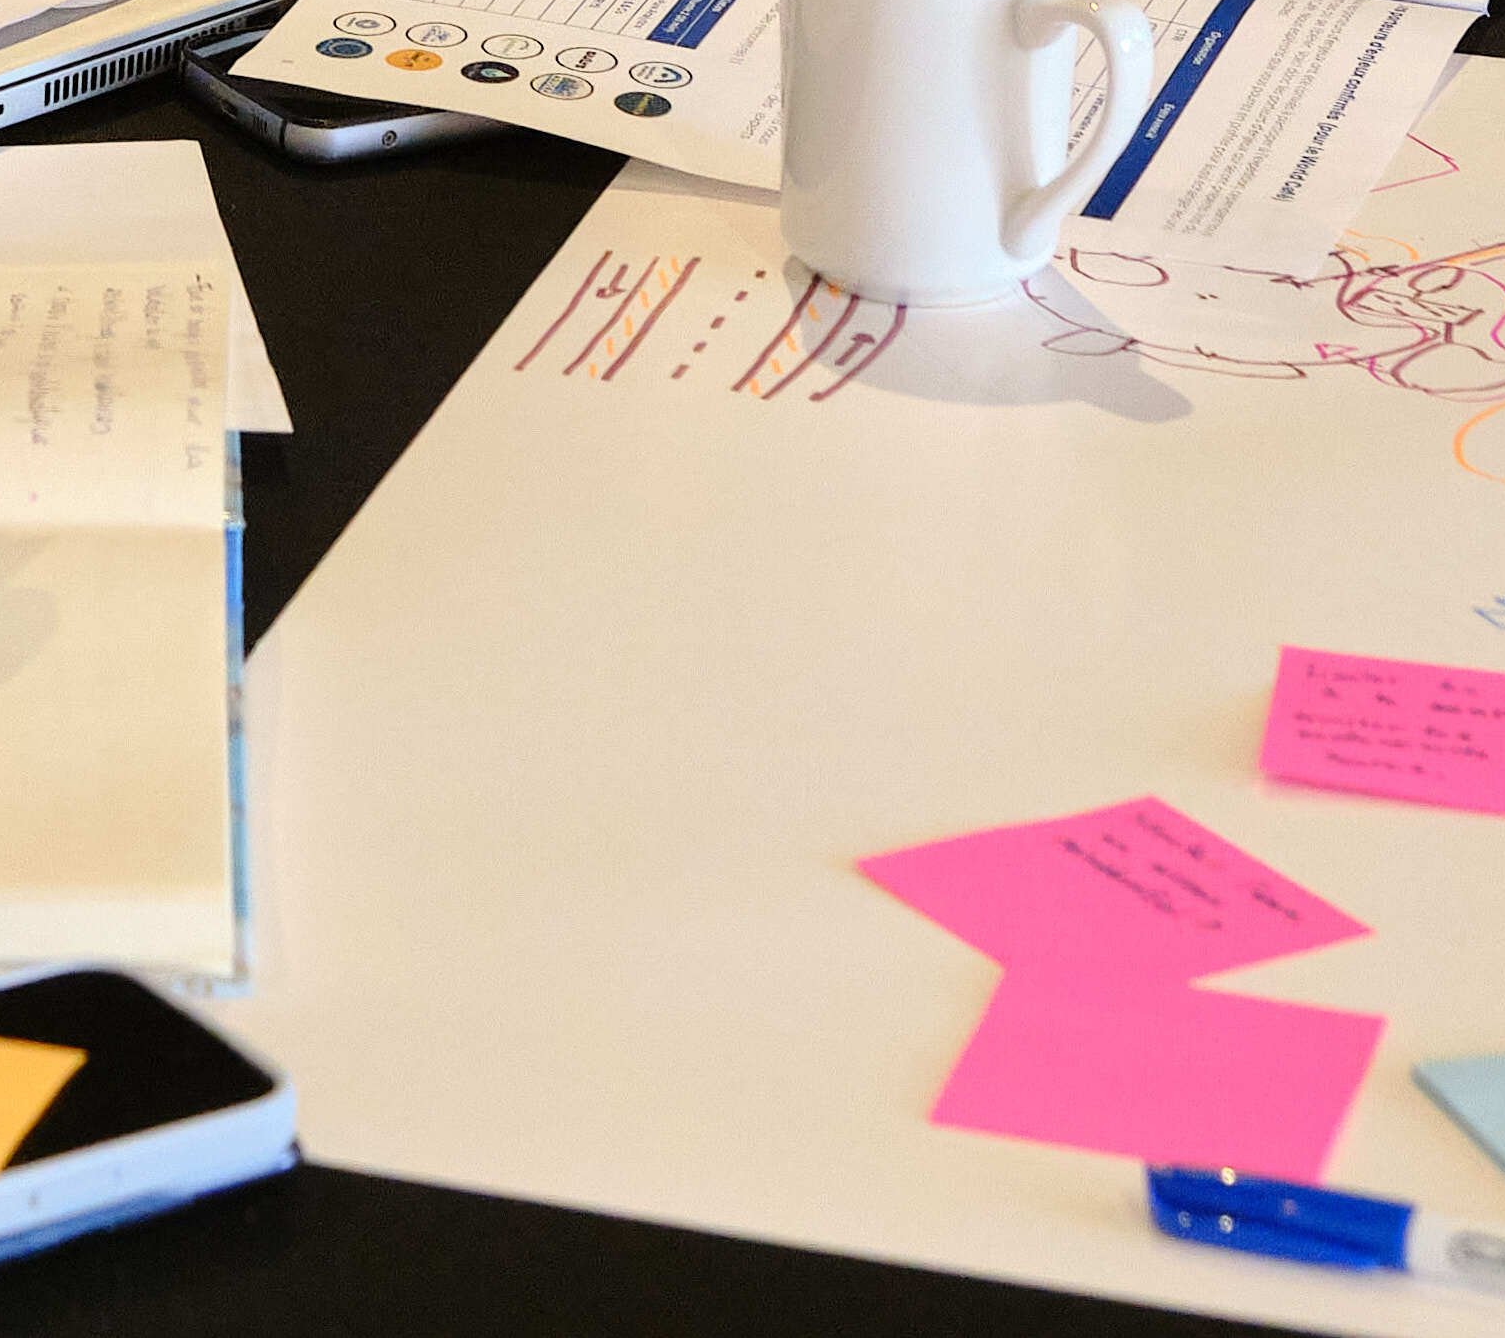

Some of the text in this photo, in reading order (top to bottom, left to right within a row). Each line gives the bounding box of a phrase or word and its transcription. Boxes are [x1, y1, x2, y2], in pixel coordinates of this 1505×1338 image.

[1349, 40, 1386, 78] d'enjeux
[1325, 78, 1364, 120] confirmés
[1310, 121, 1338, 146] (pour
[1288, 153, 1318, 181] World
